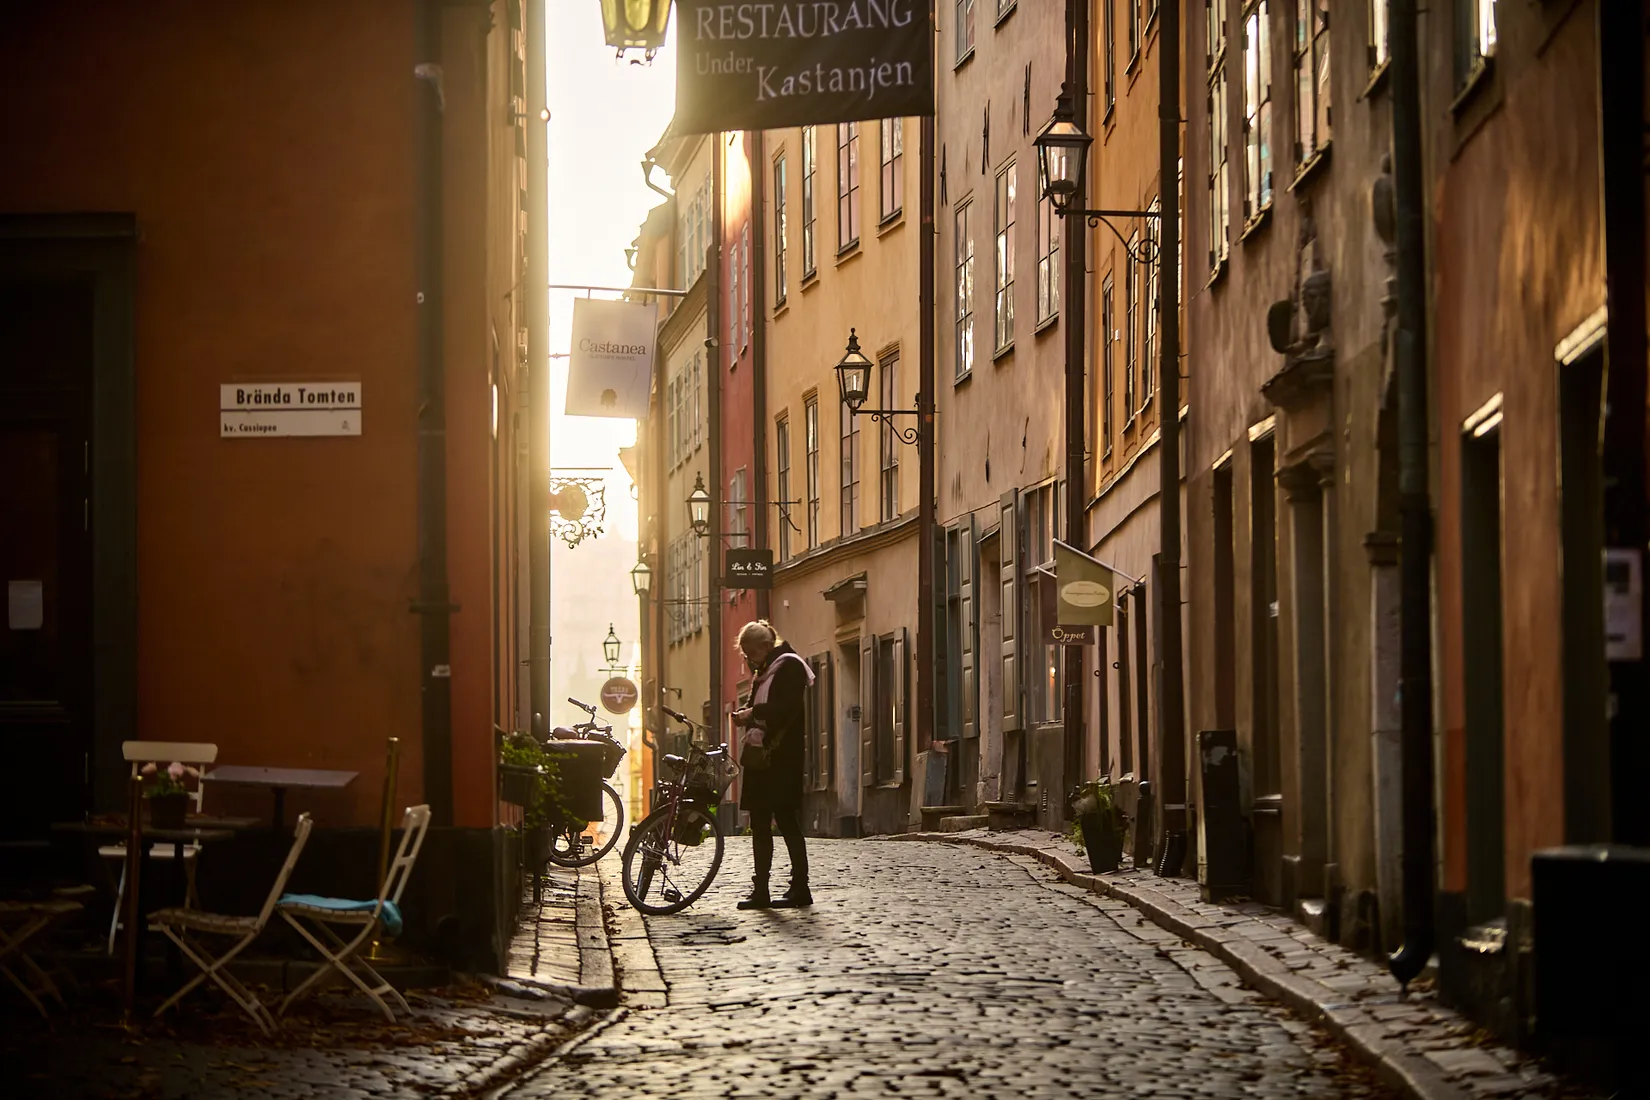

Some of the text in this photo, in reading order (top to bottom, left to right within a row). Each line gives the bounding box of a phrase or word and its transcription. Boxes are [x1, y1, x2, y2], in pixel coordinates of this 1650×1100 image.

[695, 0, 913, 41] RESTAURANG
[696, 51, 914, 101] Under Kastanjen
[579, 338, 647, 355] Castanea
[236, 387, 355, 404] Brända Tomten
[224, 422, 277, 433] kv. Cassiopea
[1052, 625, 1086, 643] Öppet
